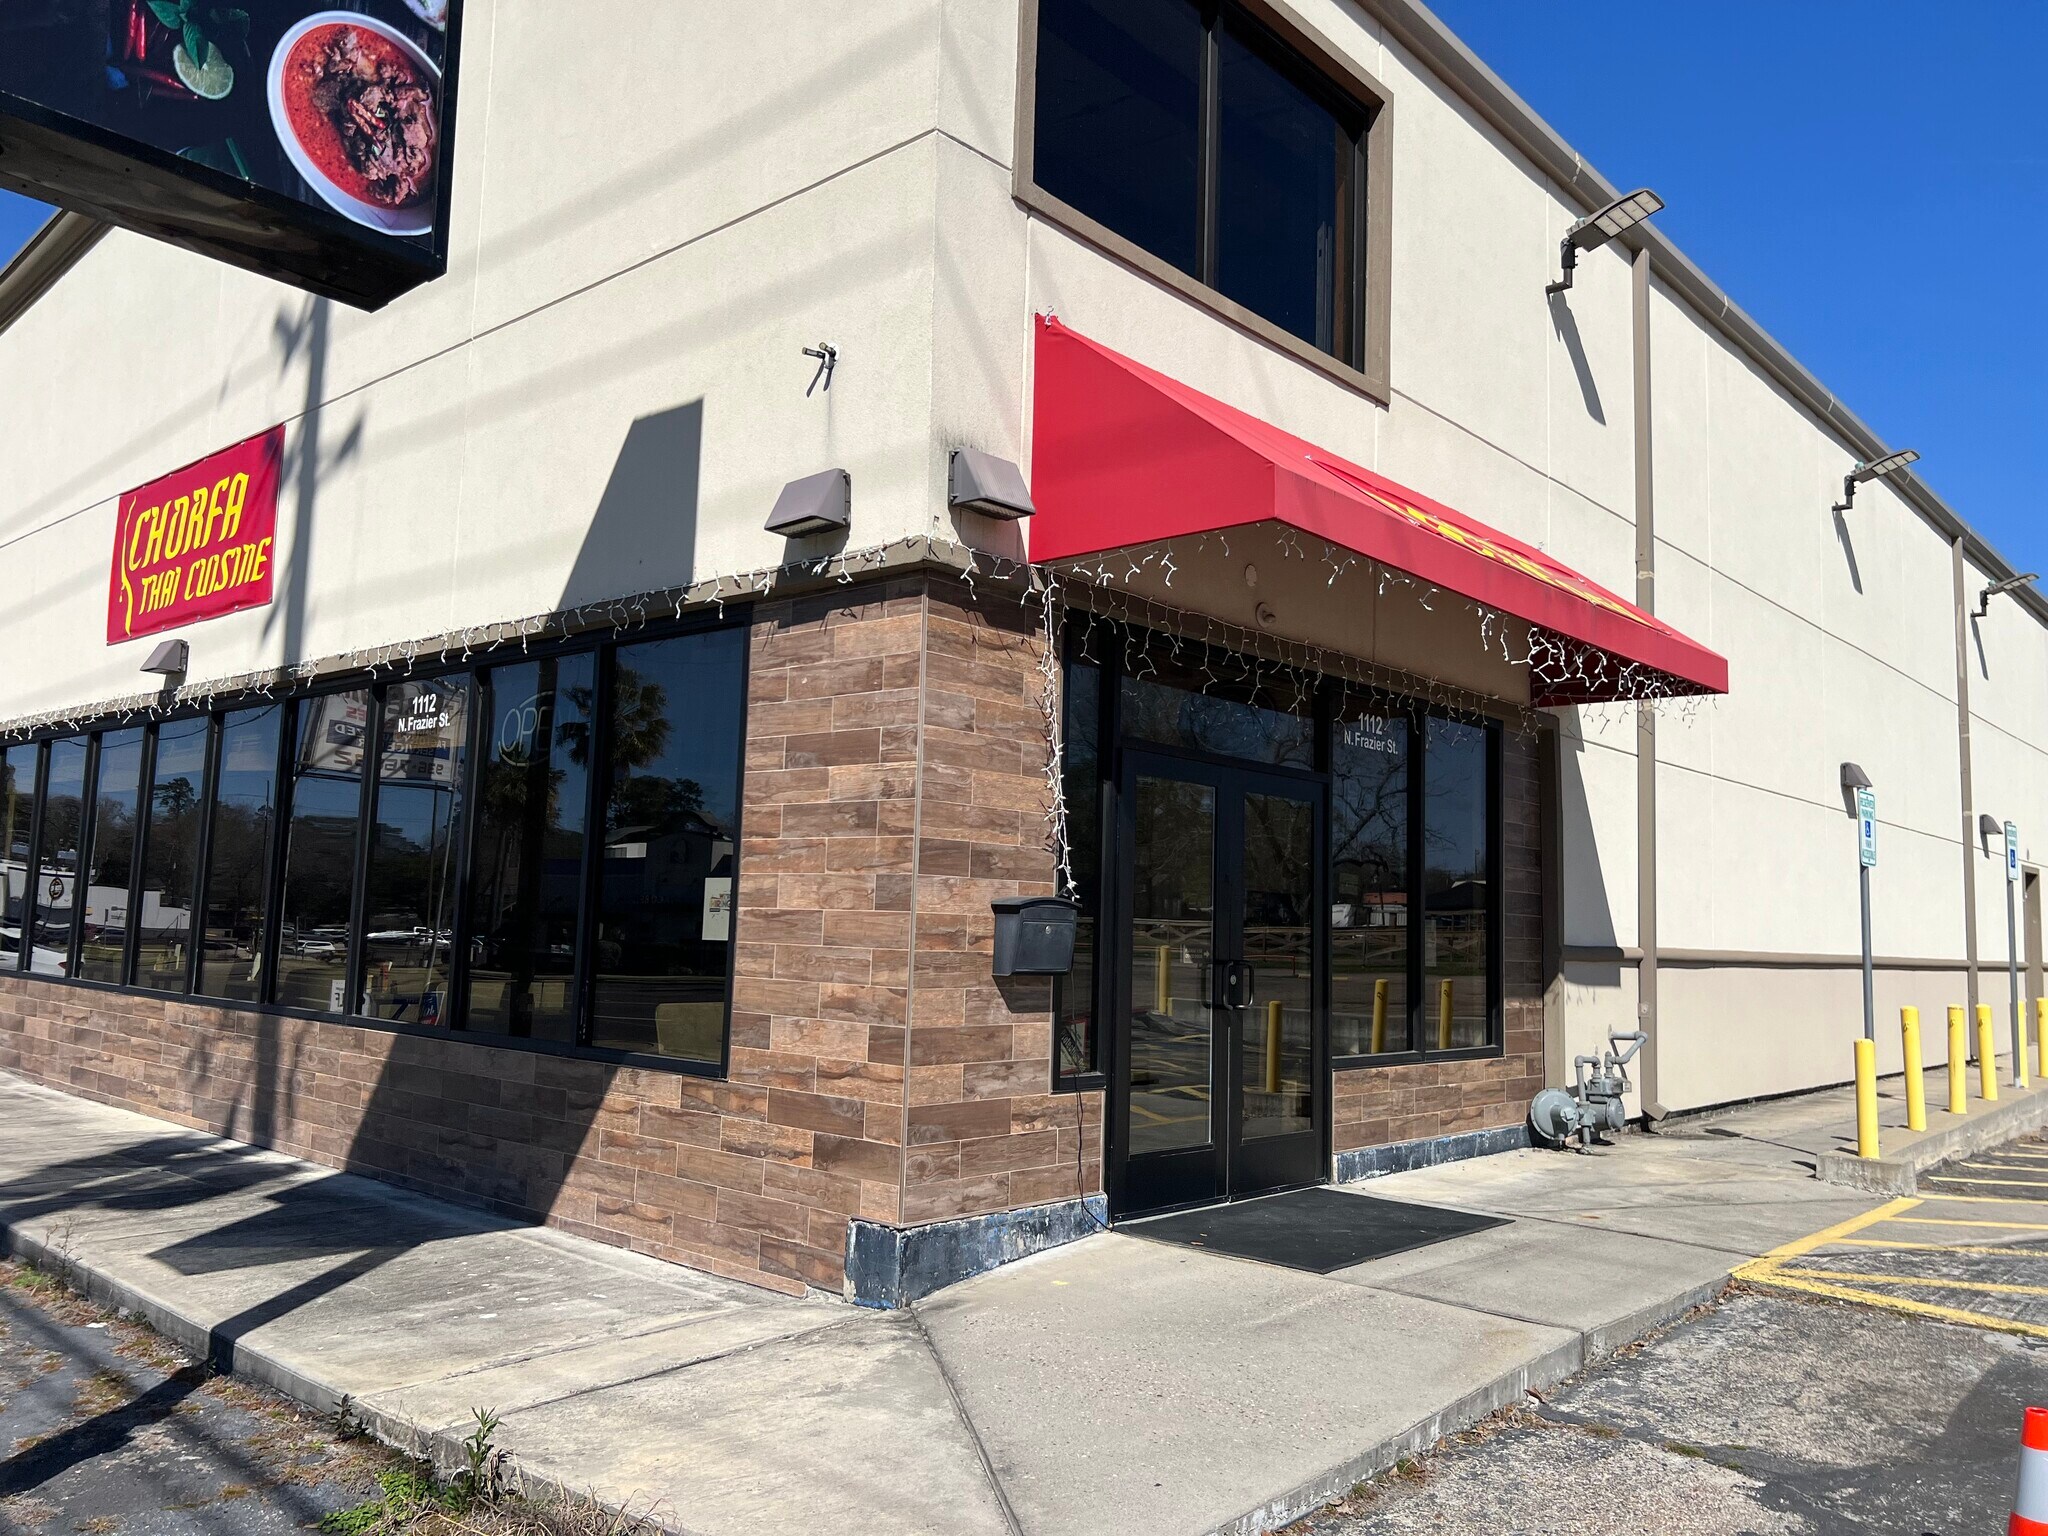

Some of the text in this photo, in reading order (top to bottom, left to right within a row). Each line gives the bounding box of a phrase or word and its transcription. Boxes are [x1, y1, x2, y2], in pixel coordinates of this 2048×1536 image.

[128, 472, 250, 571] CHORFA
[138, 536, 272, 615] THAI CUISINE
[412, 693, 437, 715] 1112
[407, 714, 438, 731] Frazier
[438, 712, 451, 728] St.
[1358, 712, 1383, 735] 1112
[1354, 732, 1386, 752] Frazier
[1387, 738, 1399, 755] St.
